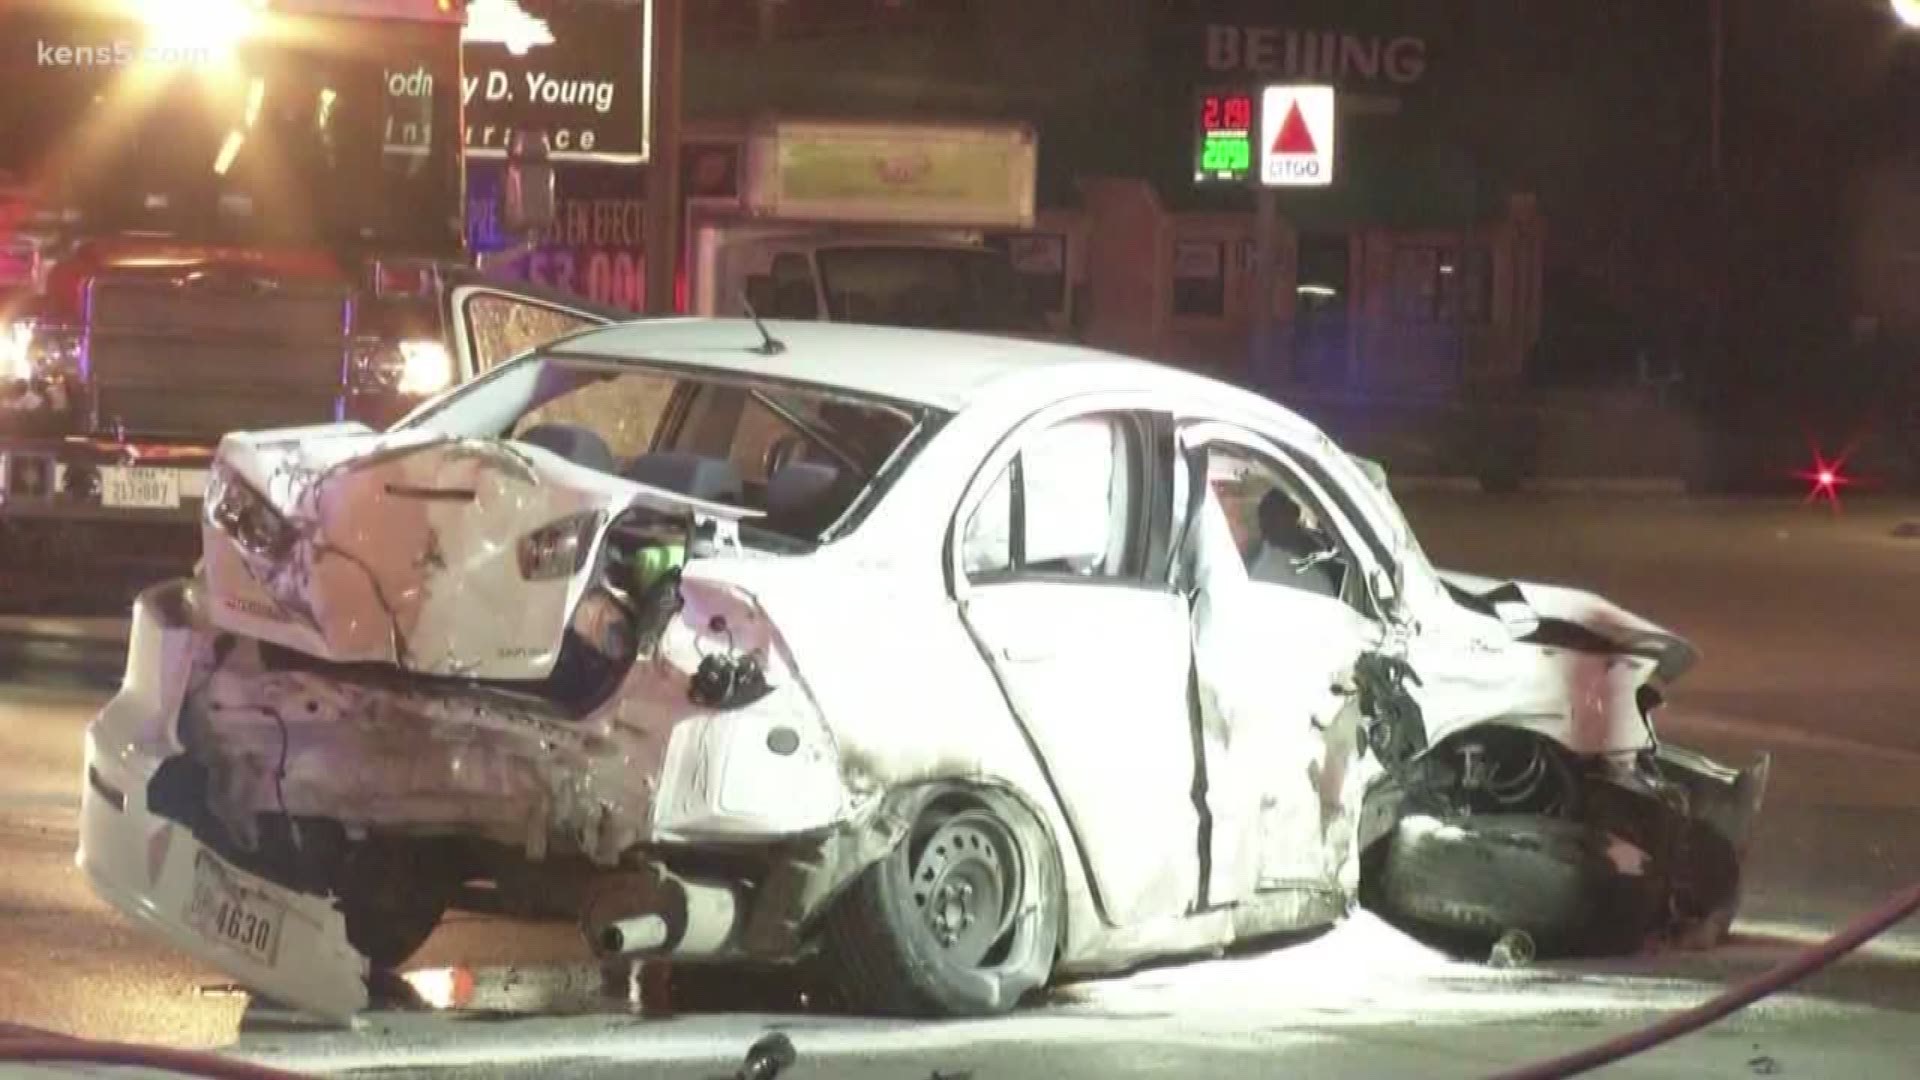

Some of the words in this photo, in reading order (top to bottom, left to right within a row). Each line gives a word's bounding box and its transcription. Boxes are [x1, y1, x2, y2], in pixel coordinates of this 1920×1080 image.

[486, 71, 513, 101] D.
[526, 71, 614, 112] Young
[1270, 160, 1320, 177] CITGO
